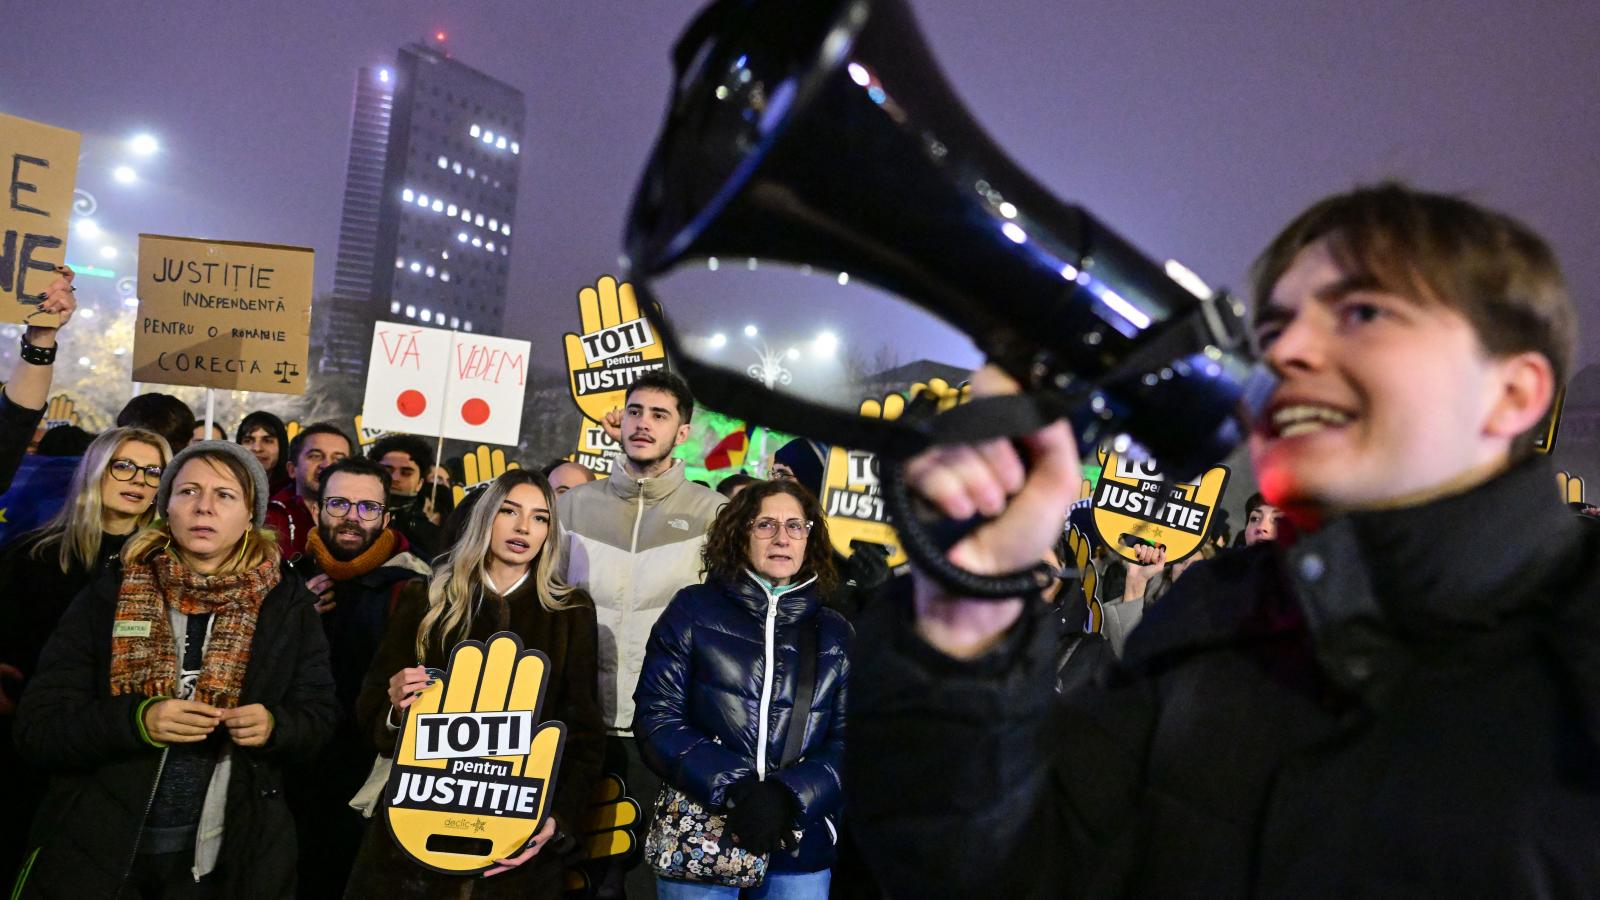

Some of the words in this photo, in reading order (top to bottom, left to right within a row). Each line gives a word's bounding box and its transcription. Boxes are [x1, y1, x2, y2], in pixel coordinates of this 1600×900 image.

[152, 256, 275, 292] JUSTIȚIE
[143, 317, 194, 336] PENTRU
[207, 326, 218, 338] O
[583, 321, 647, 357] TOȚI
[158, 351, 262, 375] CORECTA
[456, 343, 525, 386] VEDEM
[606, 353, 641, 369] pentru
[588, 429, 616, 447] TO
[420, 715, 521, 755] TOȚI
[452, 759, 508, 776] pentru
[392, 772, 538, 815] JUSTIȚIE
